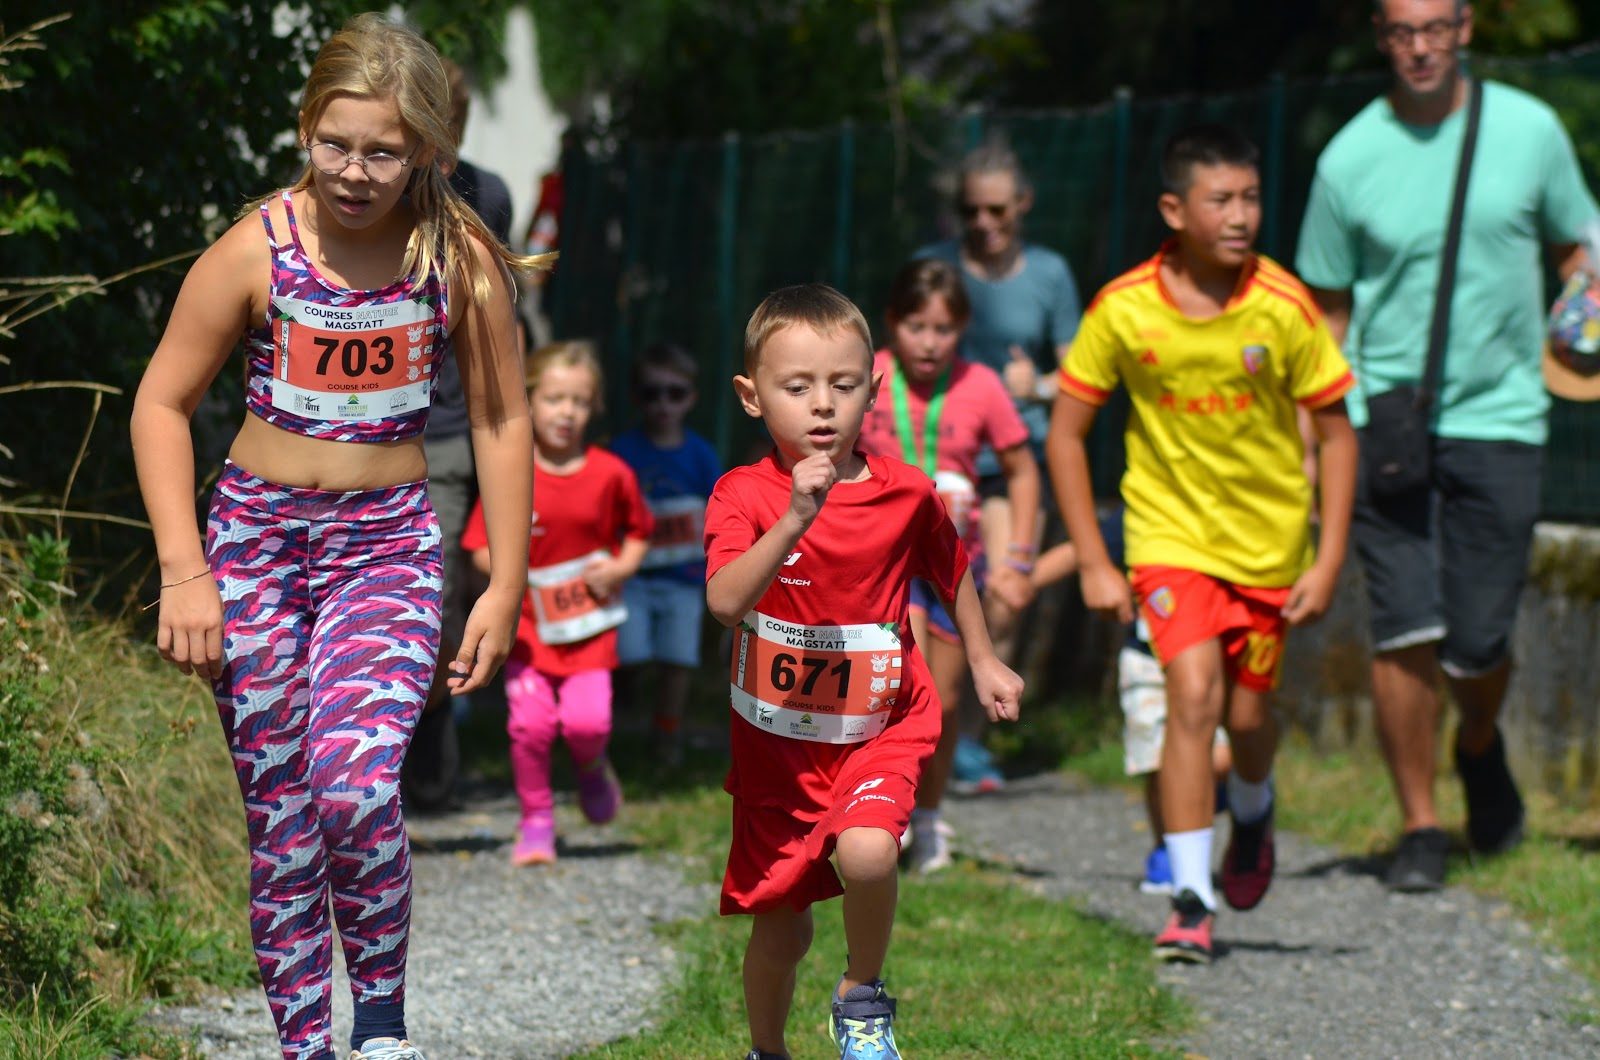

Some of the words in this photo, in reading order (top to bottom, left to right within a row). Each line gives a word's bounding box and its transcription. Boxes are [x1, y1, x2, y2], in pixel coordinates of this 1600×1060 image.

[304, 306, 353, 320] COURSES
[356, 306, 399, 320] NATURE
[325, 319, 384, 330] MAGSTATT
[313, 336, 394, 378] 703
[327, 383, 359, 391] COURSE
[361, 382, 380, 390] KIDS
[765, 620, 815, 638] COURSES
[818, 629, 862, 639] NATURE
[786, 637, 847, 649] MAGSTATT
[770, 653, 852, 699] 671
[782, 700, 814, 710] COURSE
[816, 704, 836, 712] KIDS
